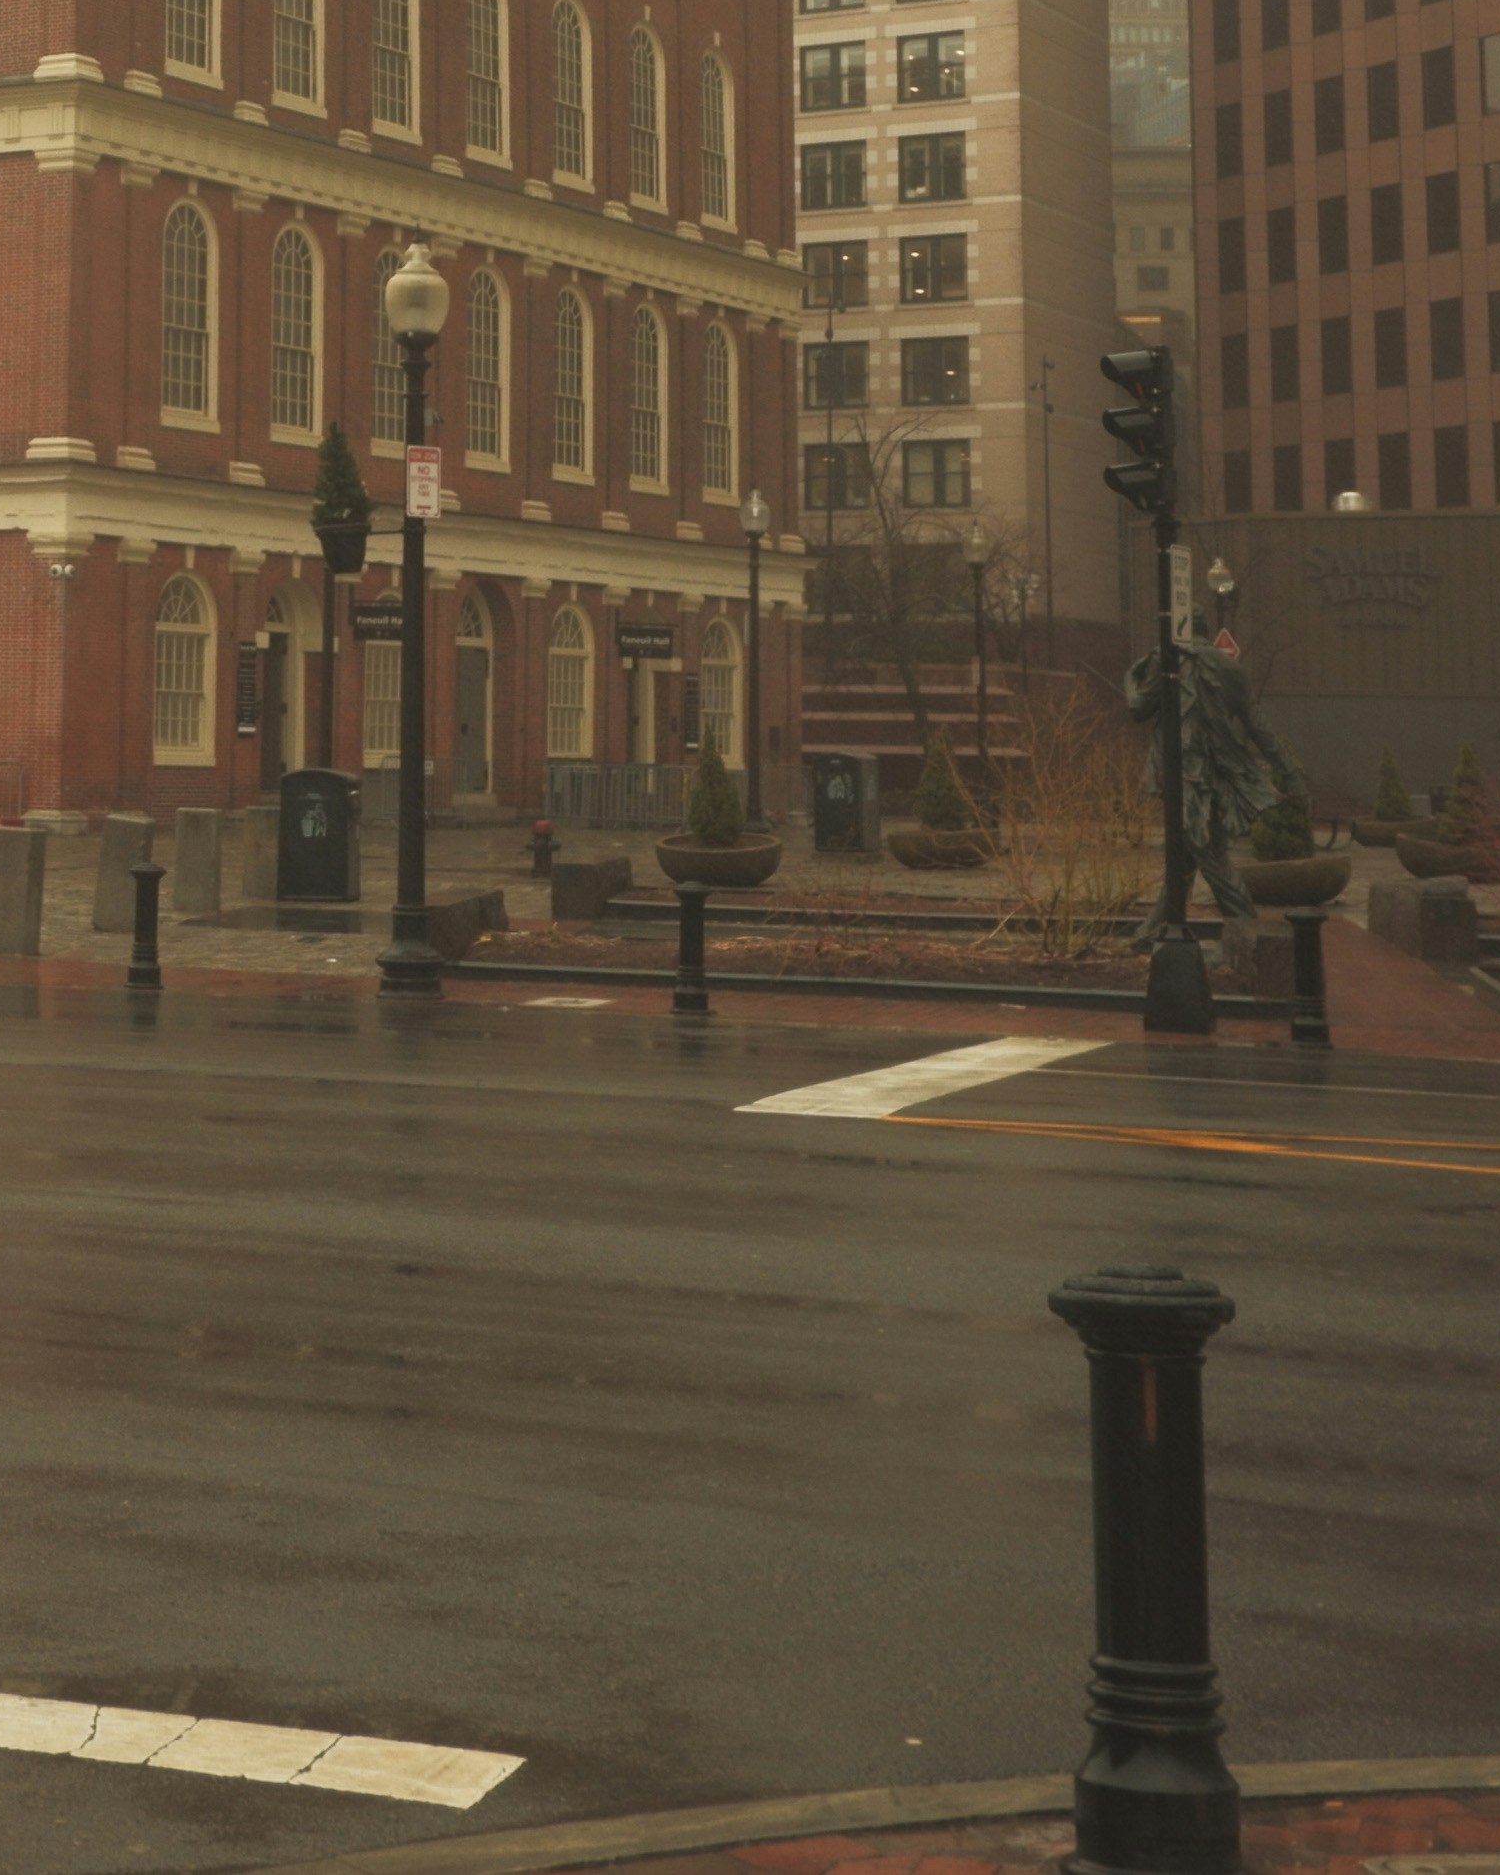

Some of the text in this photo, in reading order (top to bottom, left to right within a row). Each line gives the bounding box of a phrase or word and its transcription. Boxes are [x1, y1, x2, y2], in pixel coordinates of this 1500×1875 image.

[418, 465, 430, 475] NO
[1304, 546, 1438, 579] SAMUEL
[1321, 574, 1430, 608] ADAMS
[357, 615, 389, 625] Faneuil
[621, 635, 670, 645] Faneuil Hall
